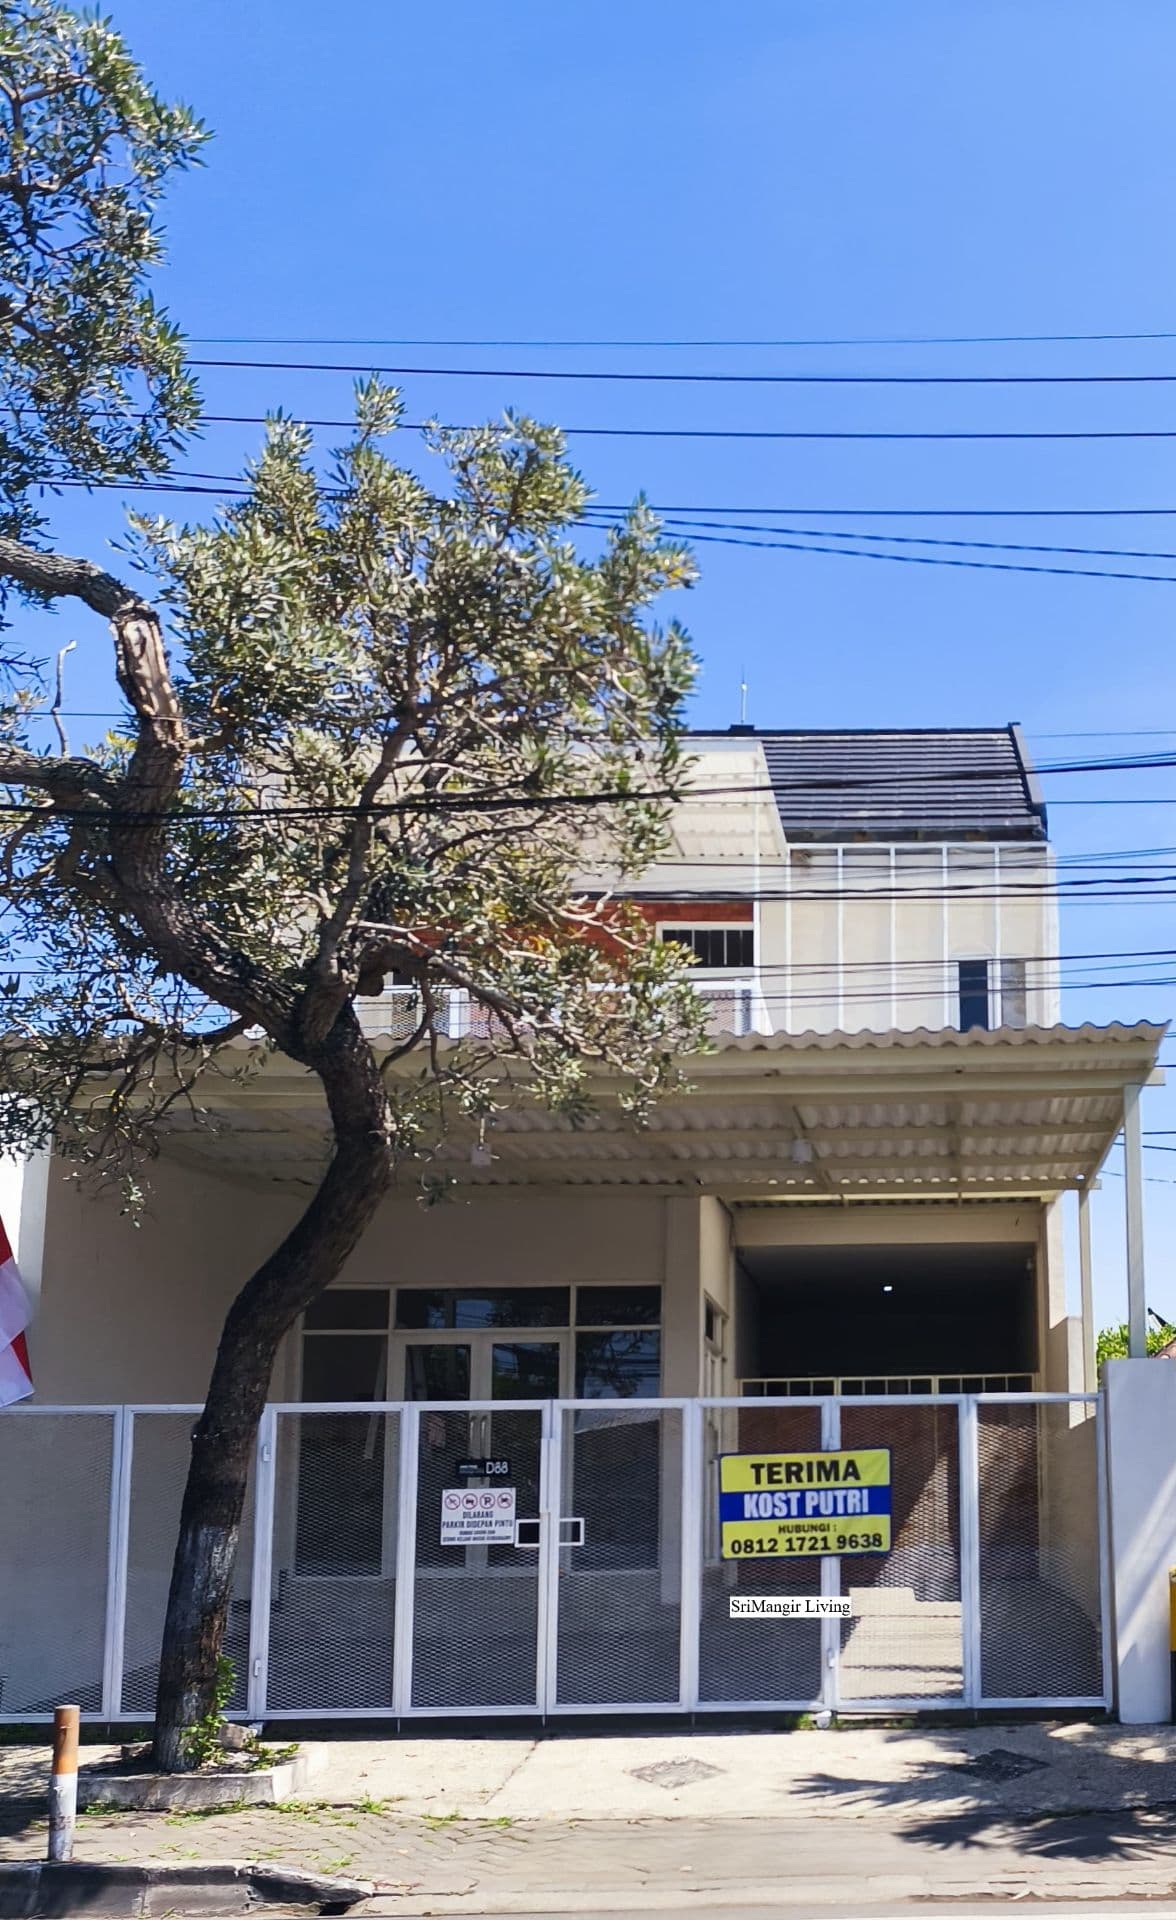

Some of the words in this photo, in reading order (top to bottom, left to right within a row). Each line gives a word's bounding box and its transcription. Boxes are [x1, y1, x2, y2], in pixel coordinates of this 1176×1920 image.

[750, 1459, 861, 1485] TERIMA
[744, 1491, 800, 1518] KOST
[805, 1488, 869, 1516] PUTRI
[463, 1511, 493, 1519] DILARANG
[778, 1523, 830, 1534] HUBUNGI
[731, 1538, 779, 1554] 0812
[785, 1536, 831, 1552] 1721
[836, 1533, 883, 1549] 9638
